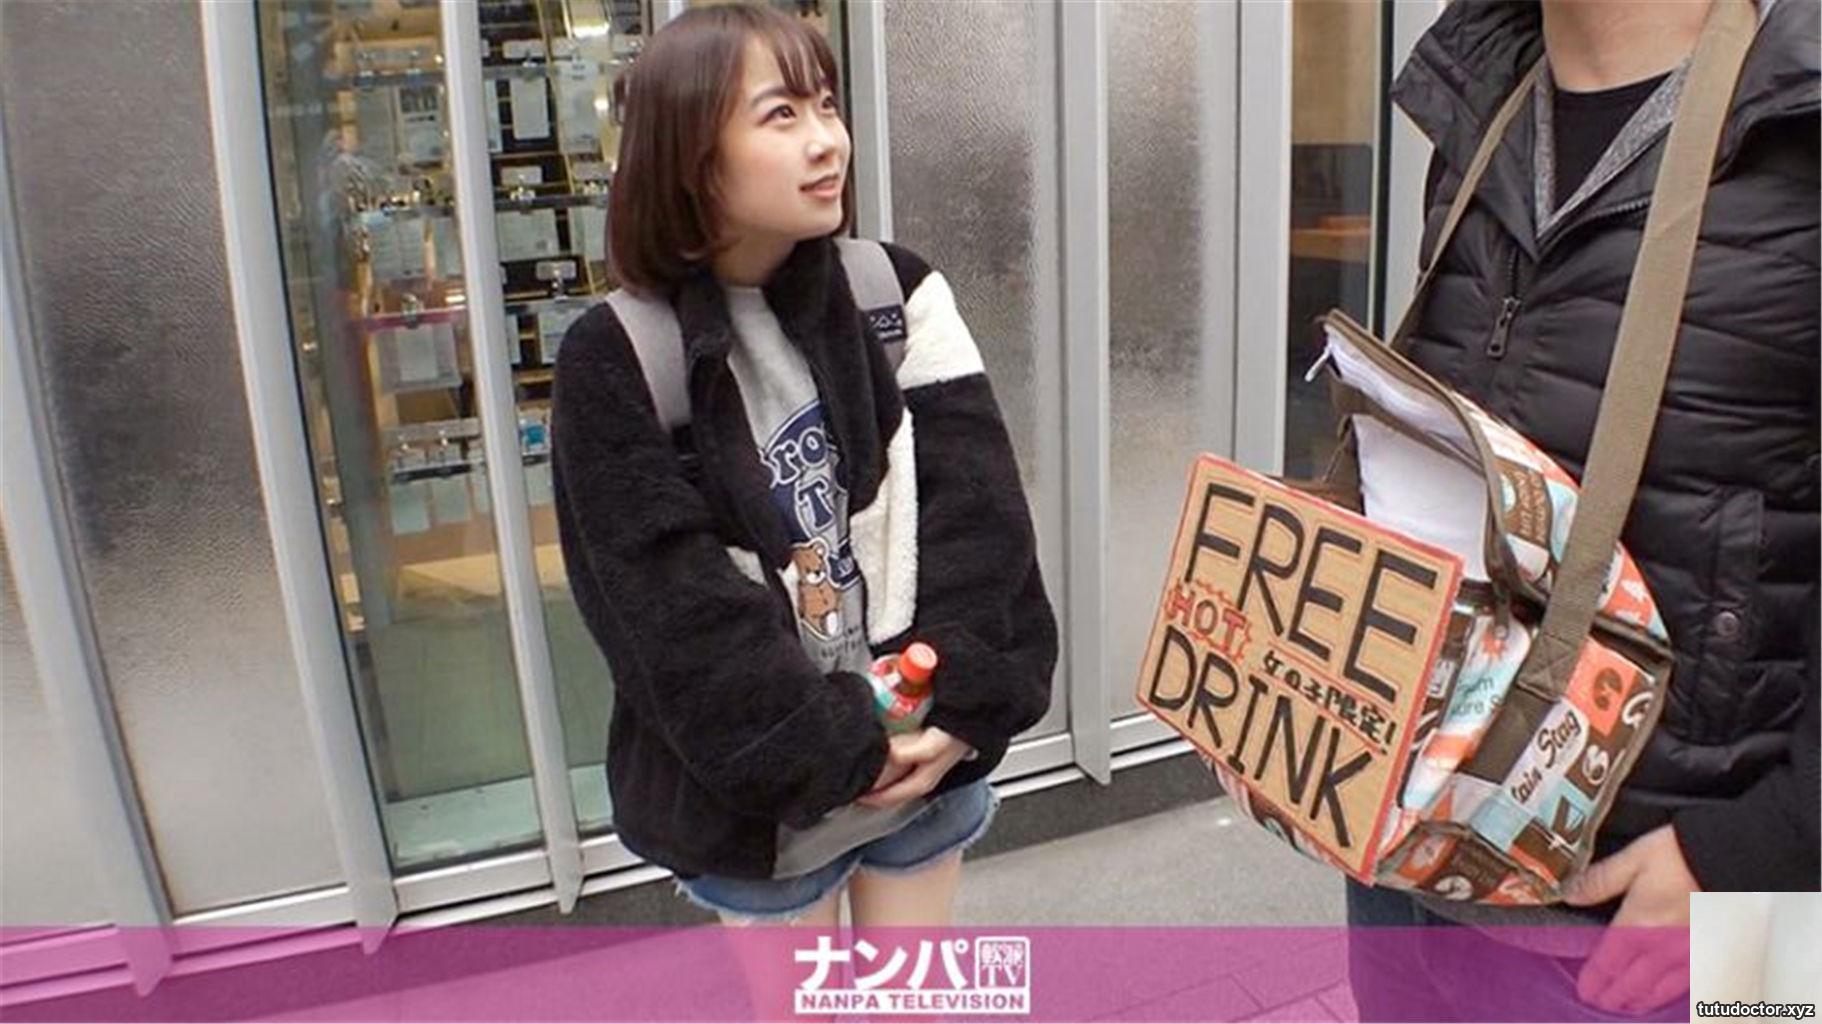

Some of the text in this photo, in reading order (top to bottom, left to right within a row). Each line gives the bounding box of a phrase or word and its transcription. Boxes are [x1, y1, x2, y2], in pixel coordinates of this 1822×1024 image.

[1167, 584, 1247, 652] HOT
[1184, 483, 1438, 703] FREE
[1148, 624, 1372, 848] DRINK
[1537, 710, 1582, 769] Stag
